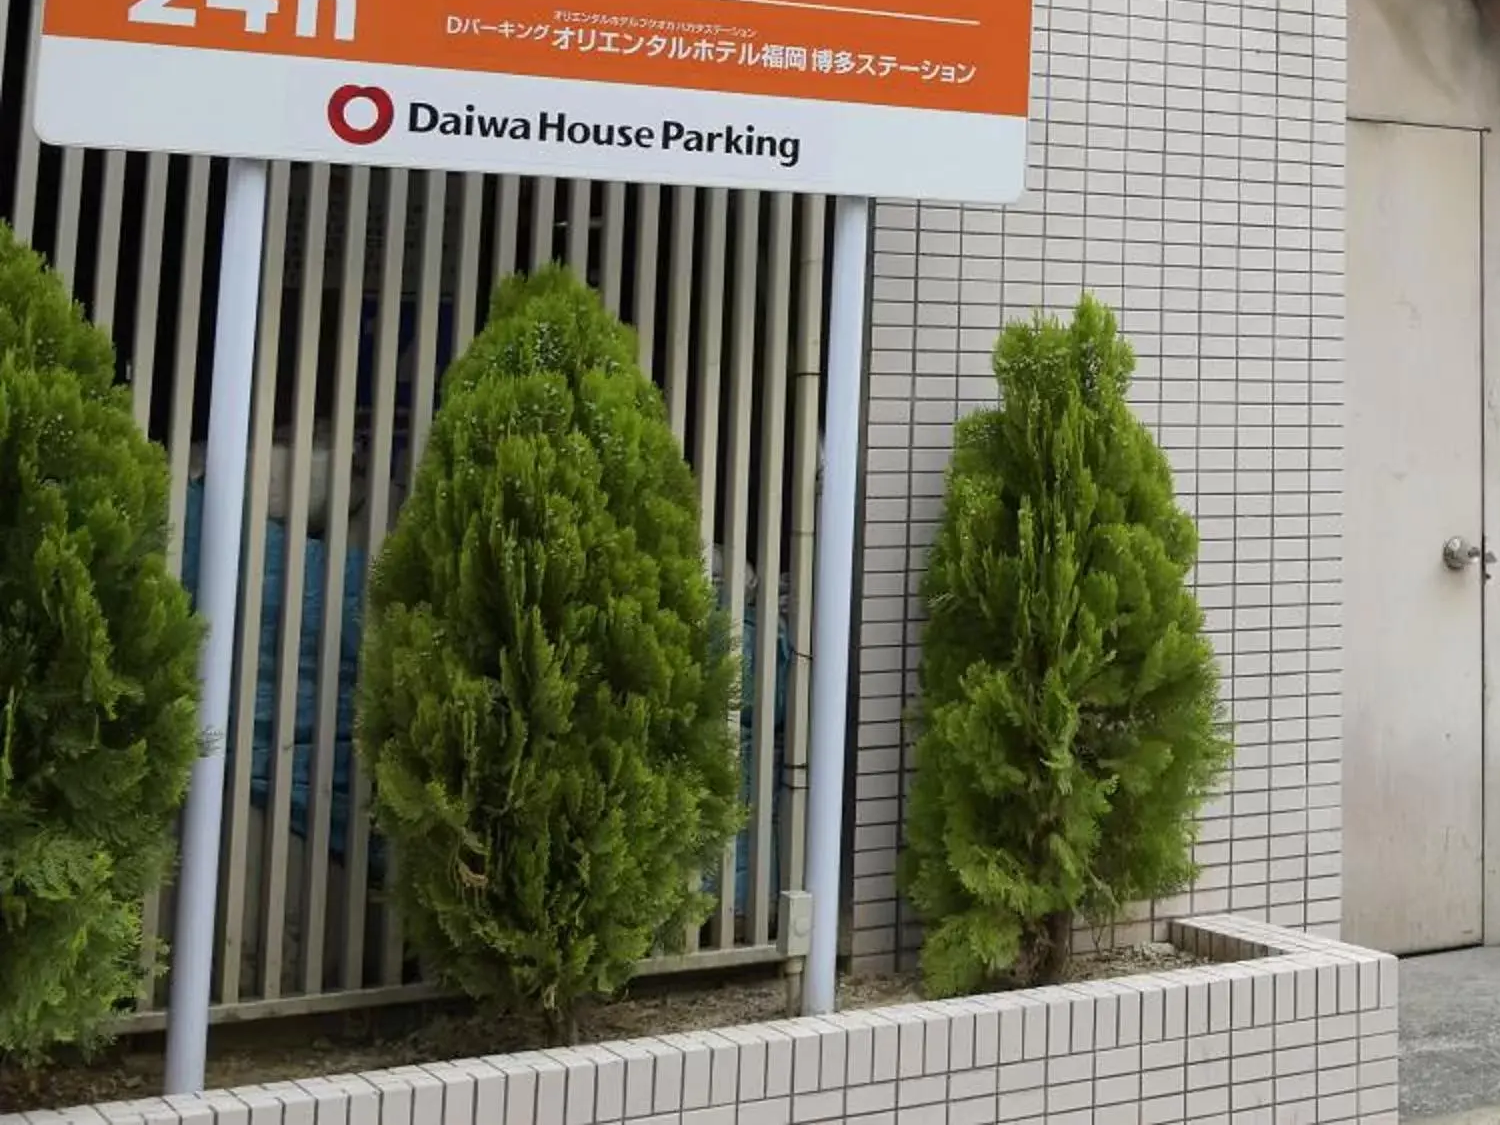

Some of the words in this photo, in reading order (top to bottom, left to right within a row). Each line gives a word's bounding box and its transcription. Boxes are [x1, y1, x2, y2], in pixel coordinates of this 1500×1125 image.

[407, 101, 534, 143] Daiwa
[539, 110, 653, 148] House
[660, 120, 801, 168] Parking
